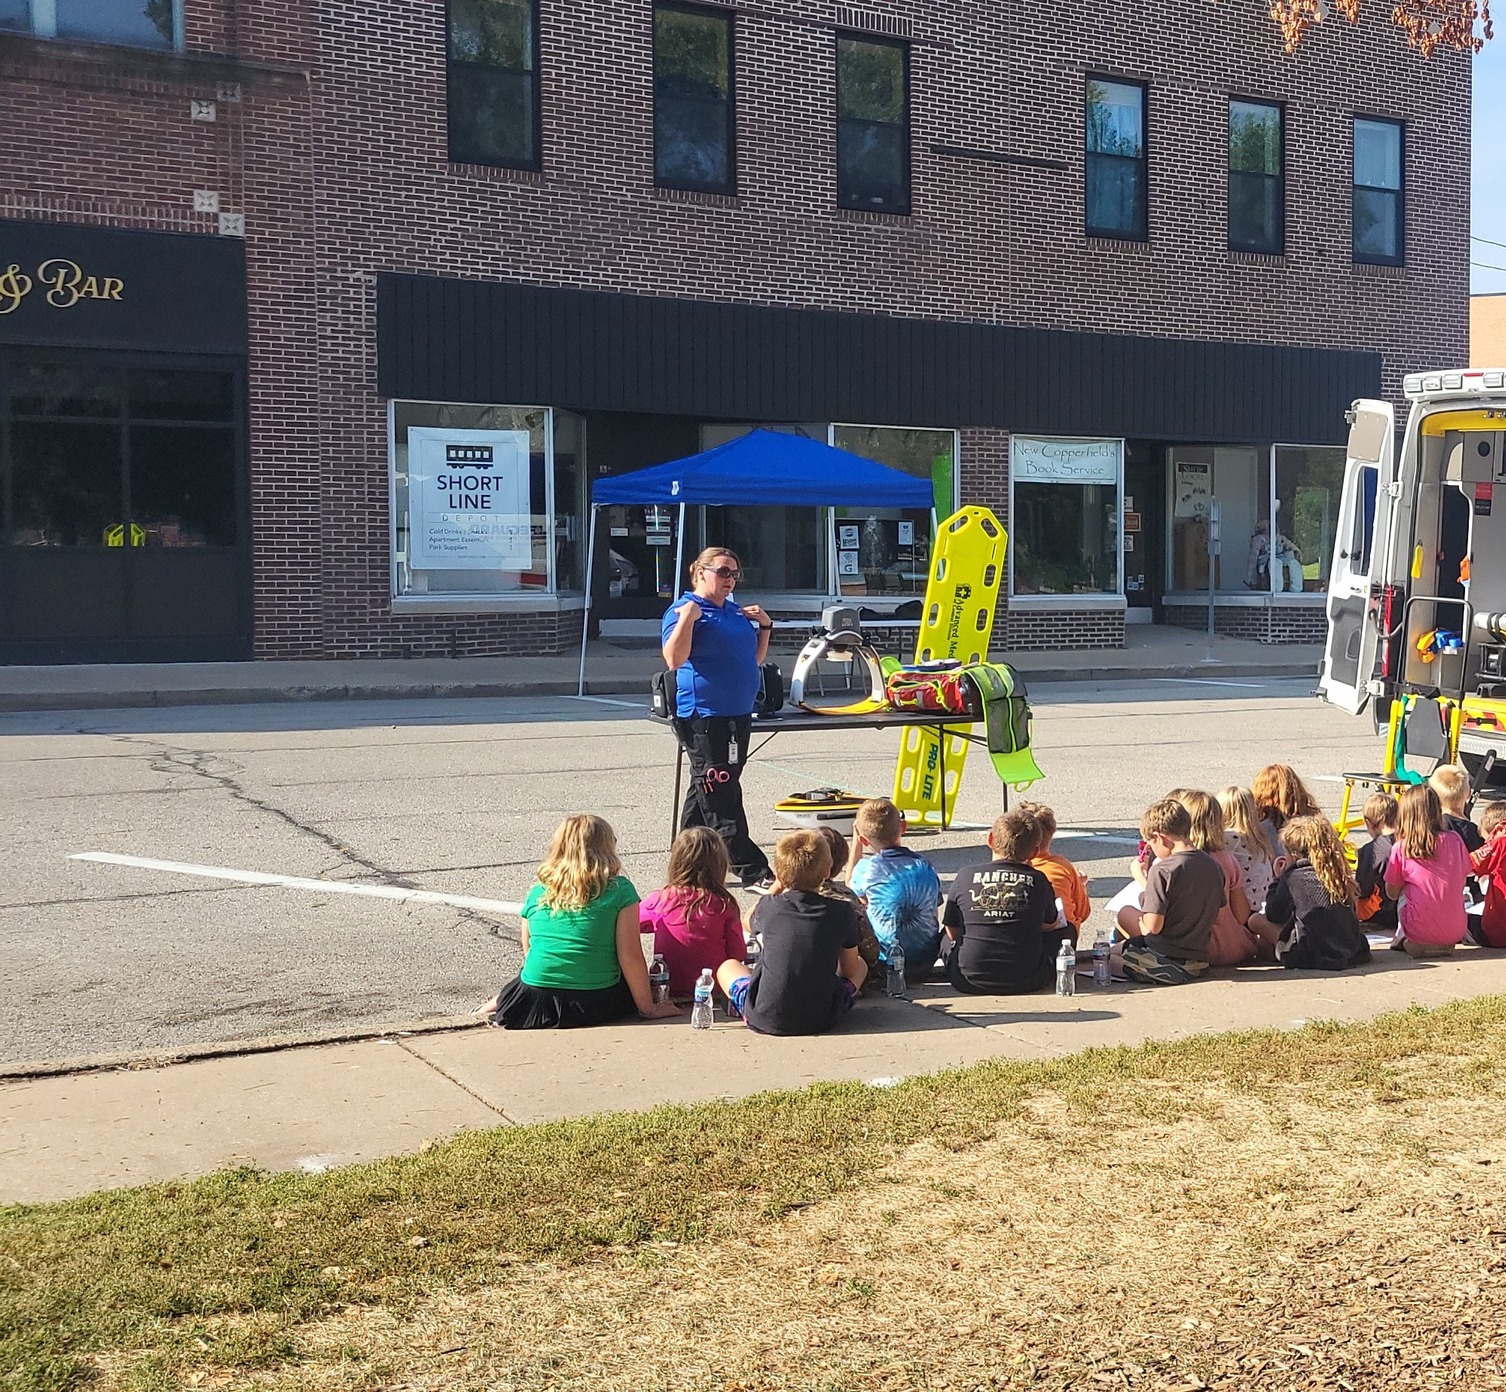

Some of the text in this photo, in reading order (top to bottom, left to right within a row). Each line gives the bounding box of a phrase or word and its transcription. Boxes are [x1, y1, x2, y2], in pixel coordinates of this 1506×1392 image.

[1014, 441, 1116, 461] New Copperfield's
[1025, 460, 1104, 476] Book Service
[437, 474, 504, 491] SHORT
[449, 493, 492, 510] LINE
[442, 514, 500, 522] DEPOT
[443, 544, 468, 552] Supplies
[972, 871, 1035, 887] RANCHER
[983, 910, 1015, 918] ARIAT
